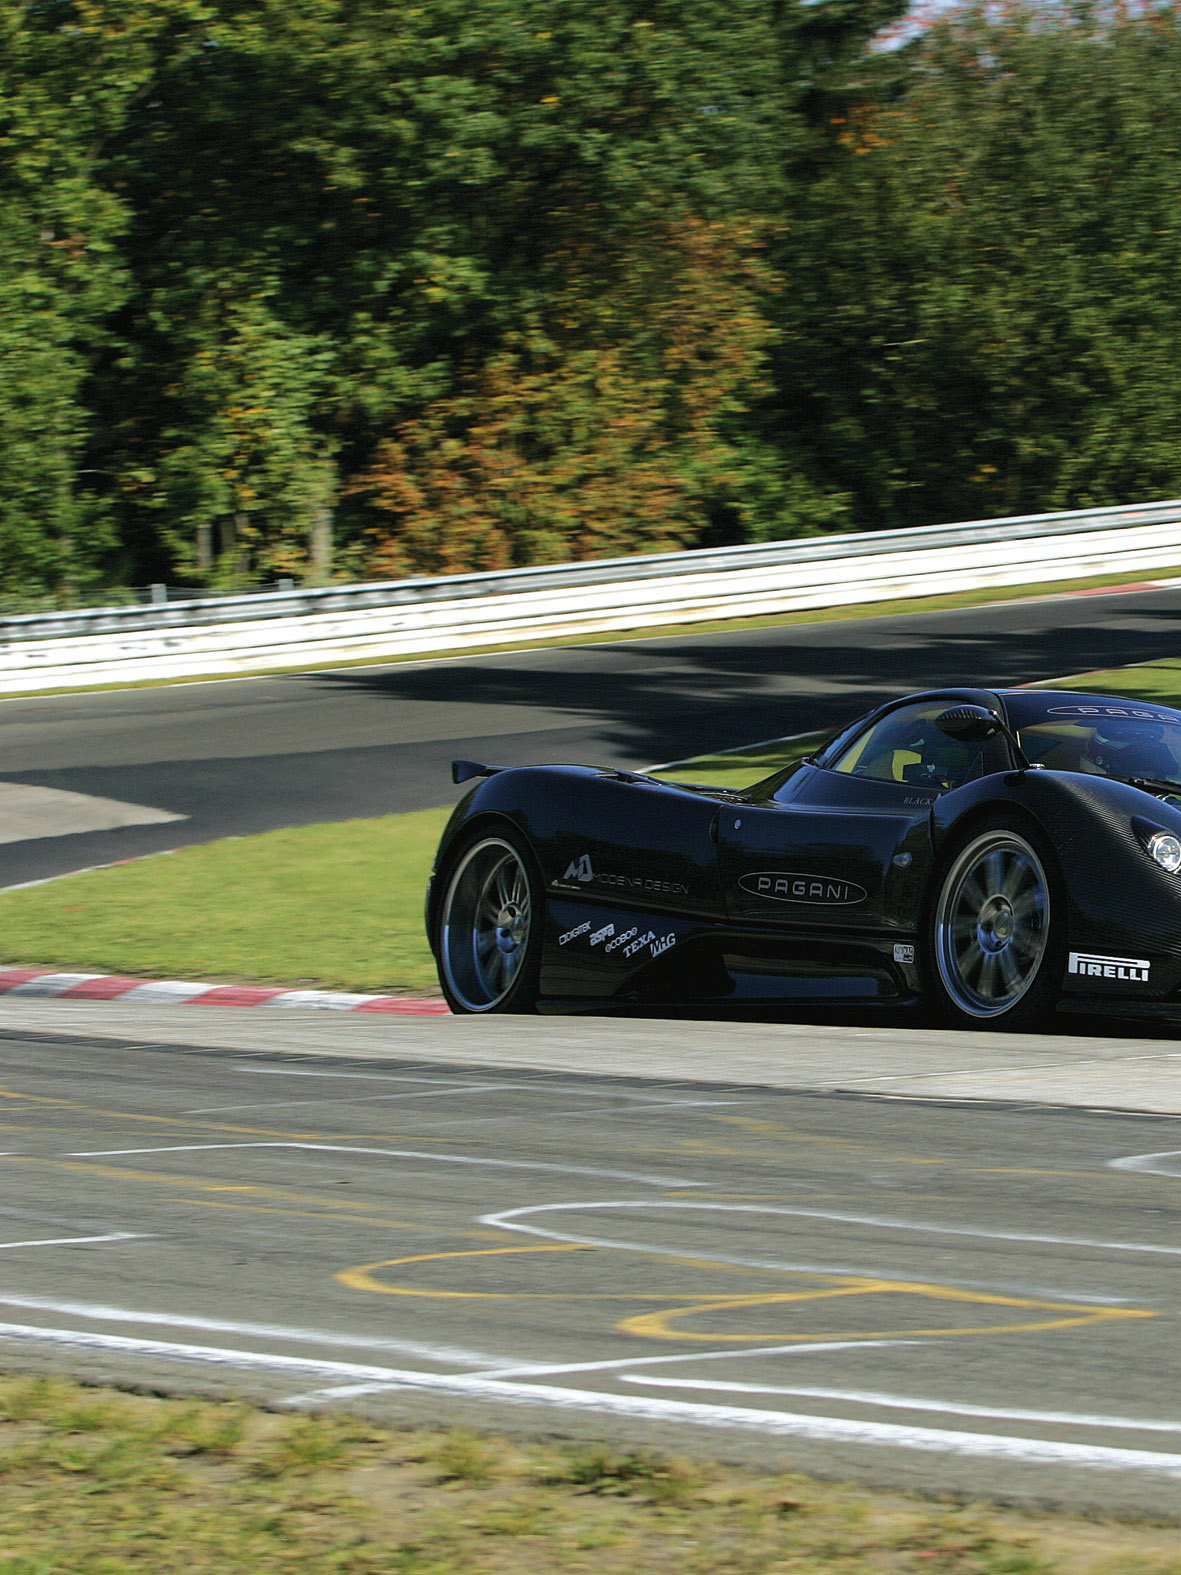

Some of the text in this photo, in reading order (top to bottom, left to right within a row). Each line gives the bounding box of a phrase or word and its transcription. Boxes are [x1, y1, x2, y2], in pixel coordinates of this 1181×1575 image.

[645, 879, 689, 894] DESIGN
[758, 877, 848, 900] PAGANI
[623, 931, 656, 958] TEXA
[1068, 952, 1151, 982] PIRELLI
